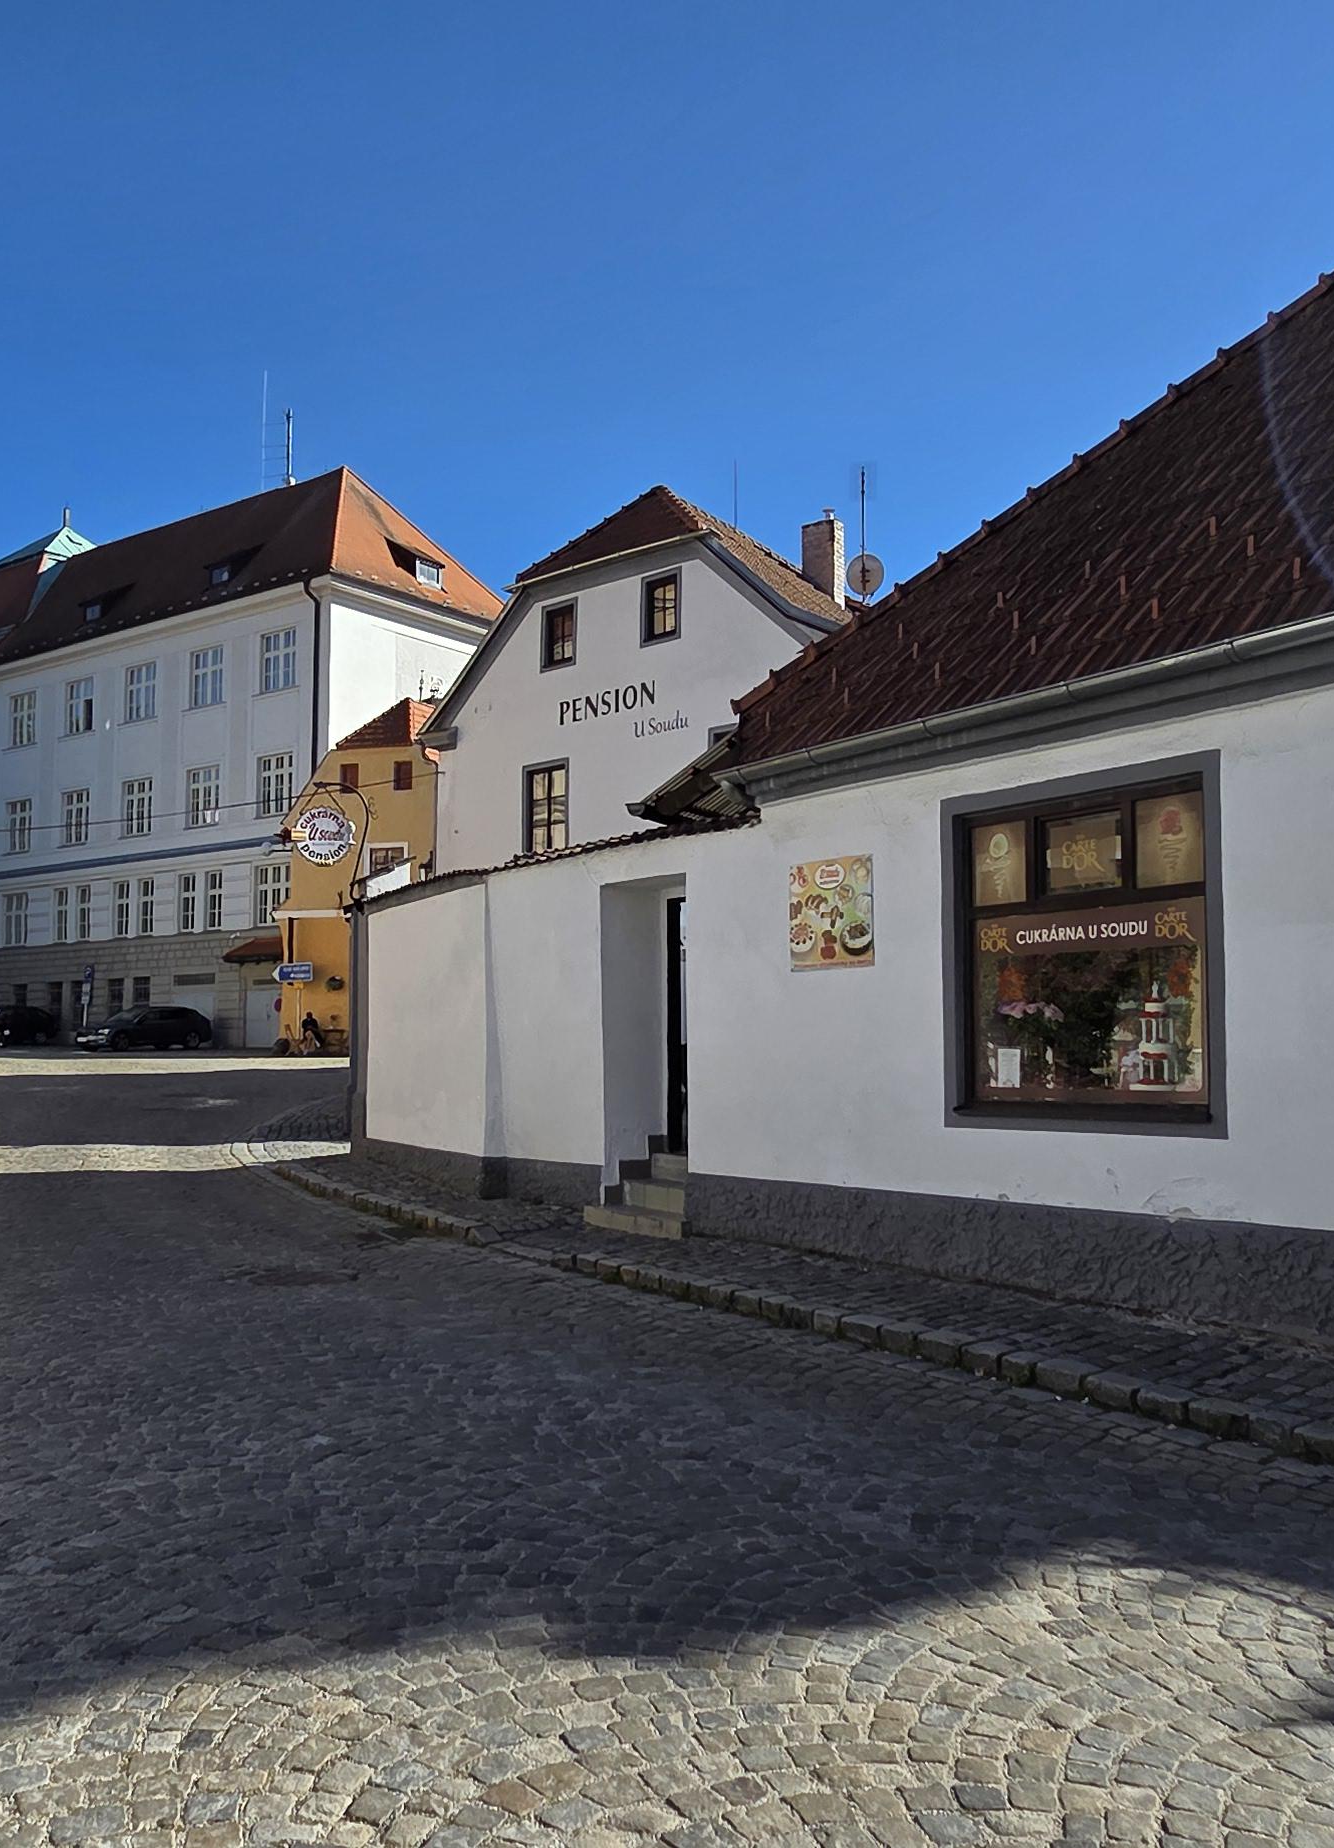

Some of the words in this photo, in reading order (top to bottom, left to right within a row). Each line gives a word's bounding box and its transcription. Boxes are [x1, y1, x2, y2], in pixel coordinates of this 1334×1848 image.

[559, 680, 656, 726] PENSION
[633, 720, 645, 738] U
[648, 710, 689, 735] Soudu
[308, 822, 319, 841] U
[1062, 839, 1097, 854] CARTE
[1155, 911, 1188, 924] CARTE
[1015, 924, 1085, 945] CUKRÁRNA
[1089, 925, 1098, 939] U
[1100, 920, 1148, 938] SOUDU
